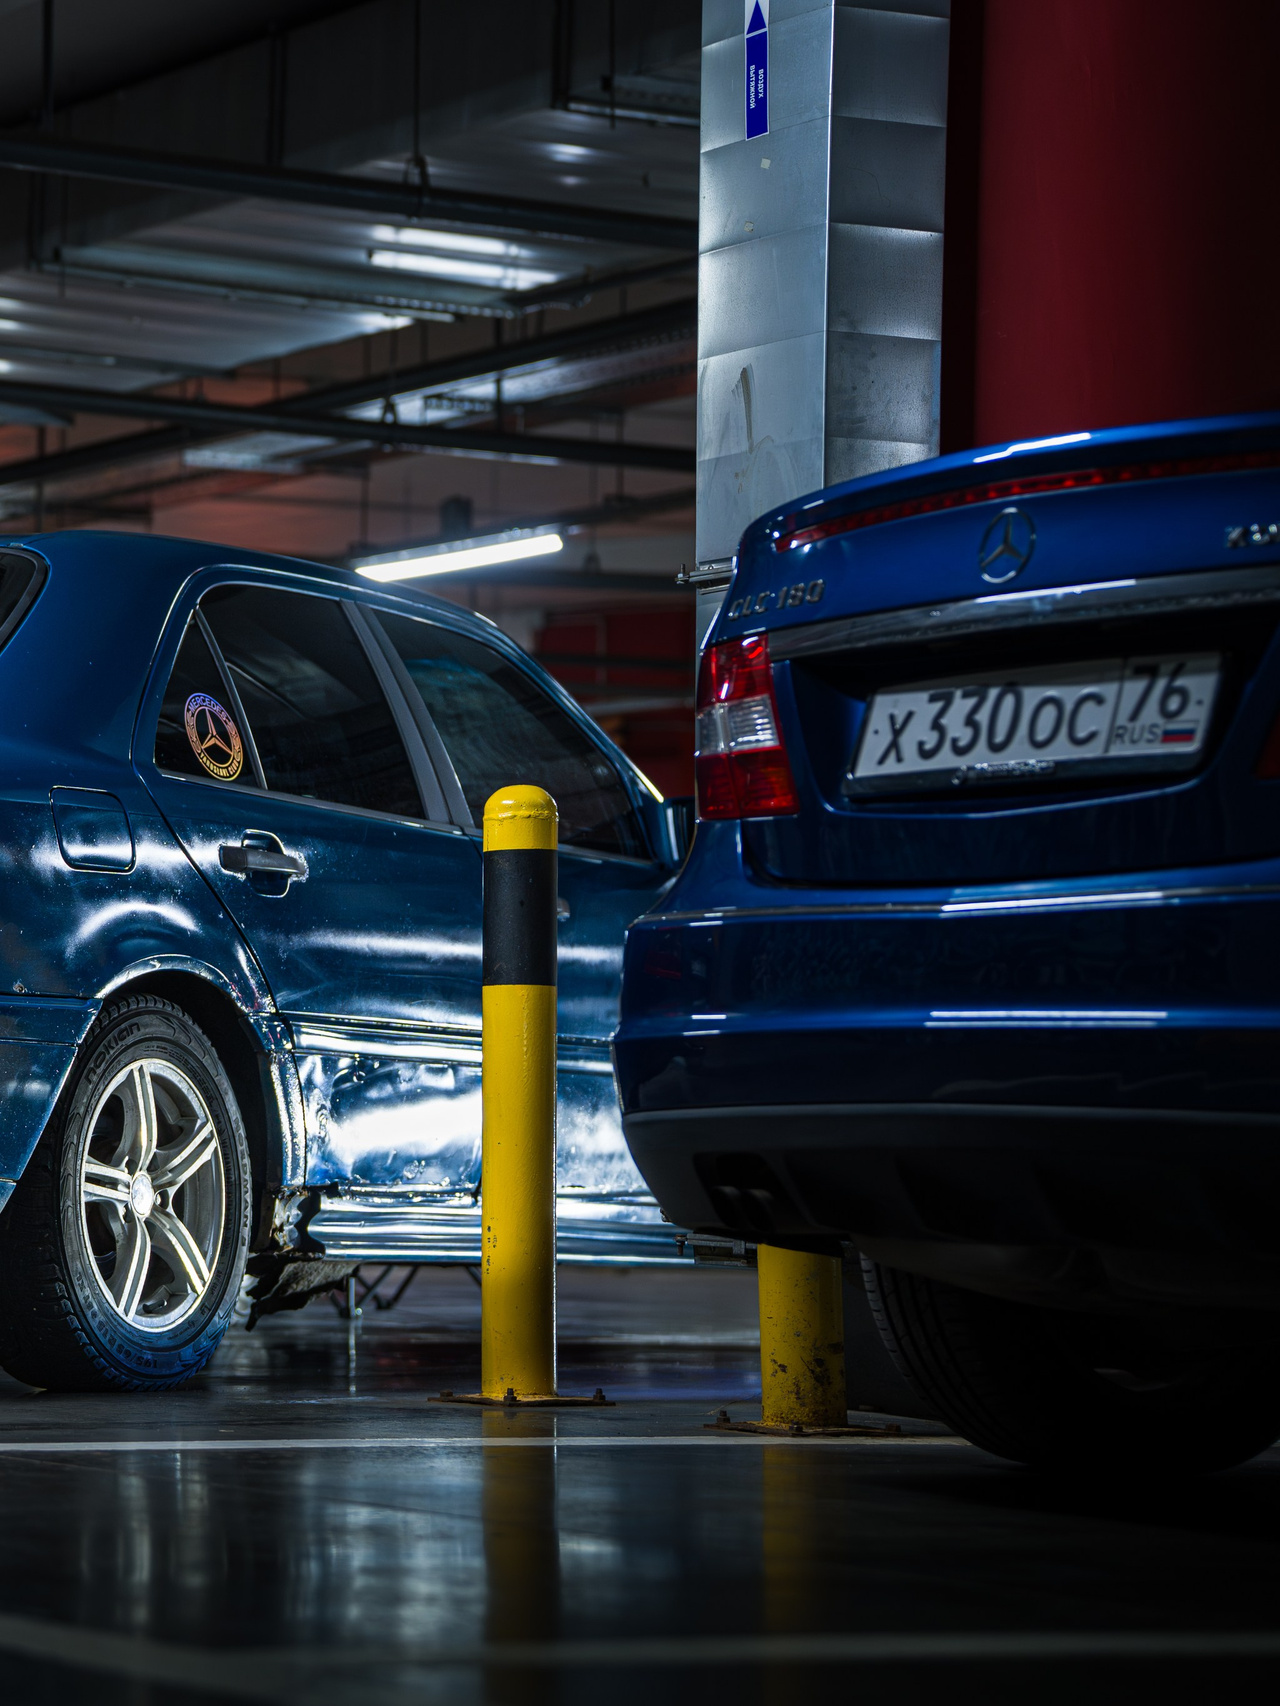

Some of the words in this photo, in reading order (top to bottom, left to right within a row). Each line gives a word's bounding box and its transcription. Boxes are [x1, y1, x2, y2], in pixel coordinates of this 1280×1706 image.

[776, 579, 825, 609] 180
[1127, 662, 1192, 723] 76
[188, 696, 228, 721] MERCEDES
[1116, 722, 1160, 746] RUS
